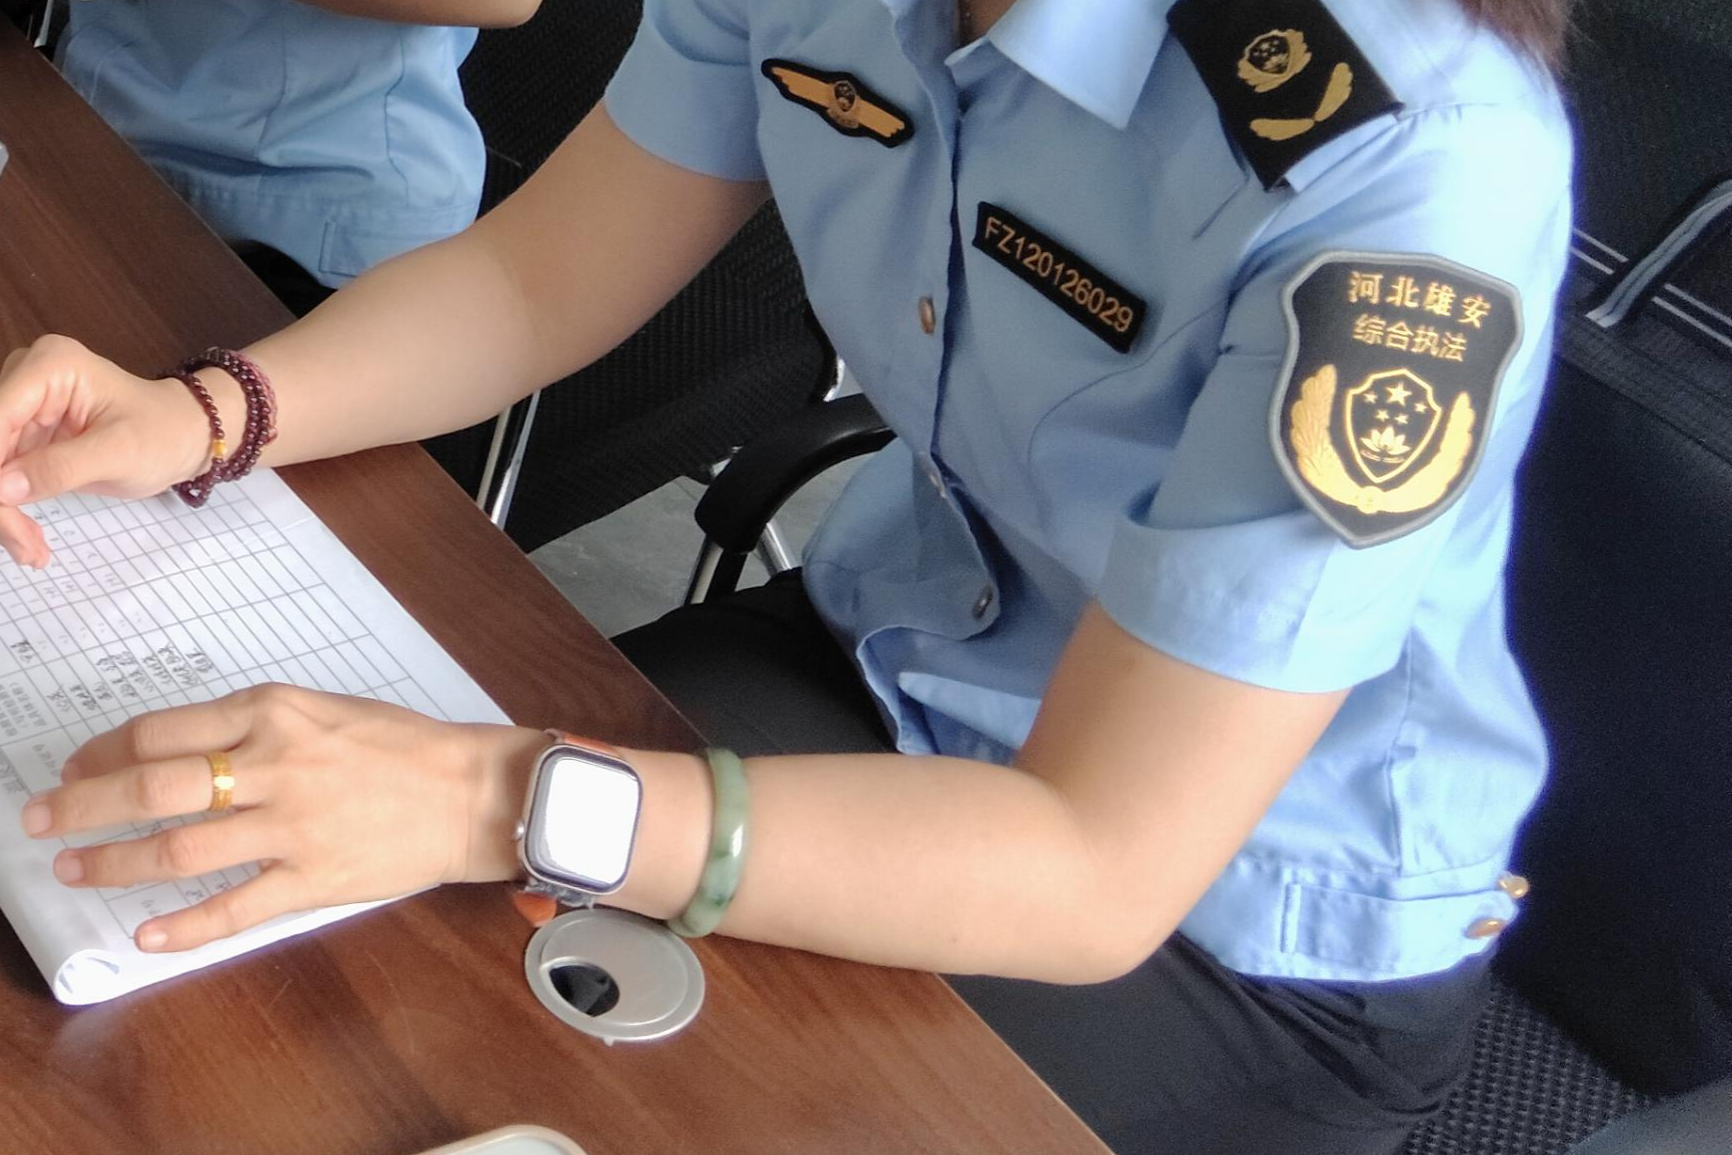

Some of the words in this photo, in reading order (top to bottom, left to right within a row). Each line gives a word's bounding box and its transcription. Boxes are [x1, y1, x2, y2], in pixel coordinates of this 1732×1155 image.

[984, 216, 1134, 333] FZ120126029
[1349, 271, 1491, 329] 河北雄安
[1352, 313, 1468, 363] 综合执法
